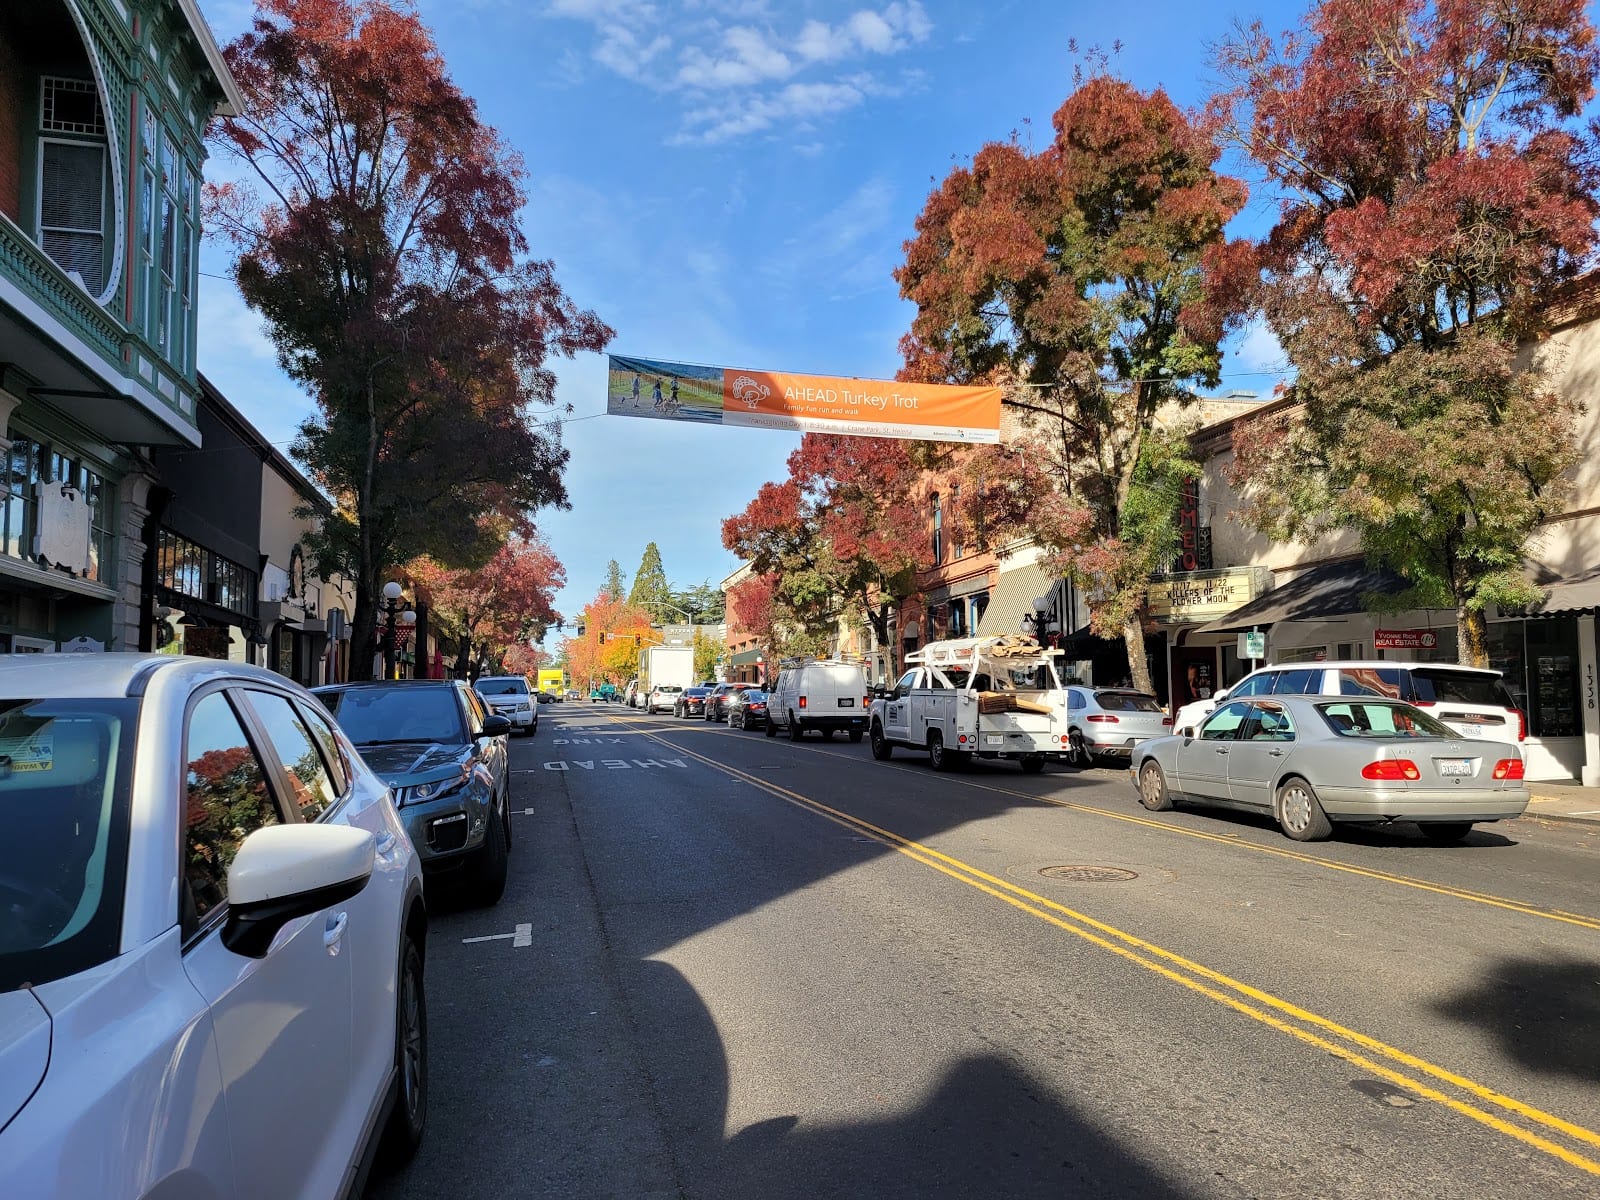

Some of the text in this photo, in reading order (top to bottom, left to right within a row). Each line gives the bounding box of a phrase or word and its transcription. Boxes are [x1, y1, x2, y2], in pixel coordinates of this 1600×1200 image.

[784, 386, 918, 410] AHEAD Turkey Trot
[784, 403, 804, 413] Family
[806, 405, 817, 413] fun
[831, 406, 842, 414] and
[789, 421, 801, 430] Day
[1167, 586, 1235, 599] KILLERS OF THE
[1172, 594, 1228, 606] FLOWER MOON
[544, 760, 688, 770] AHEAD
